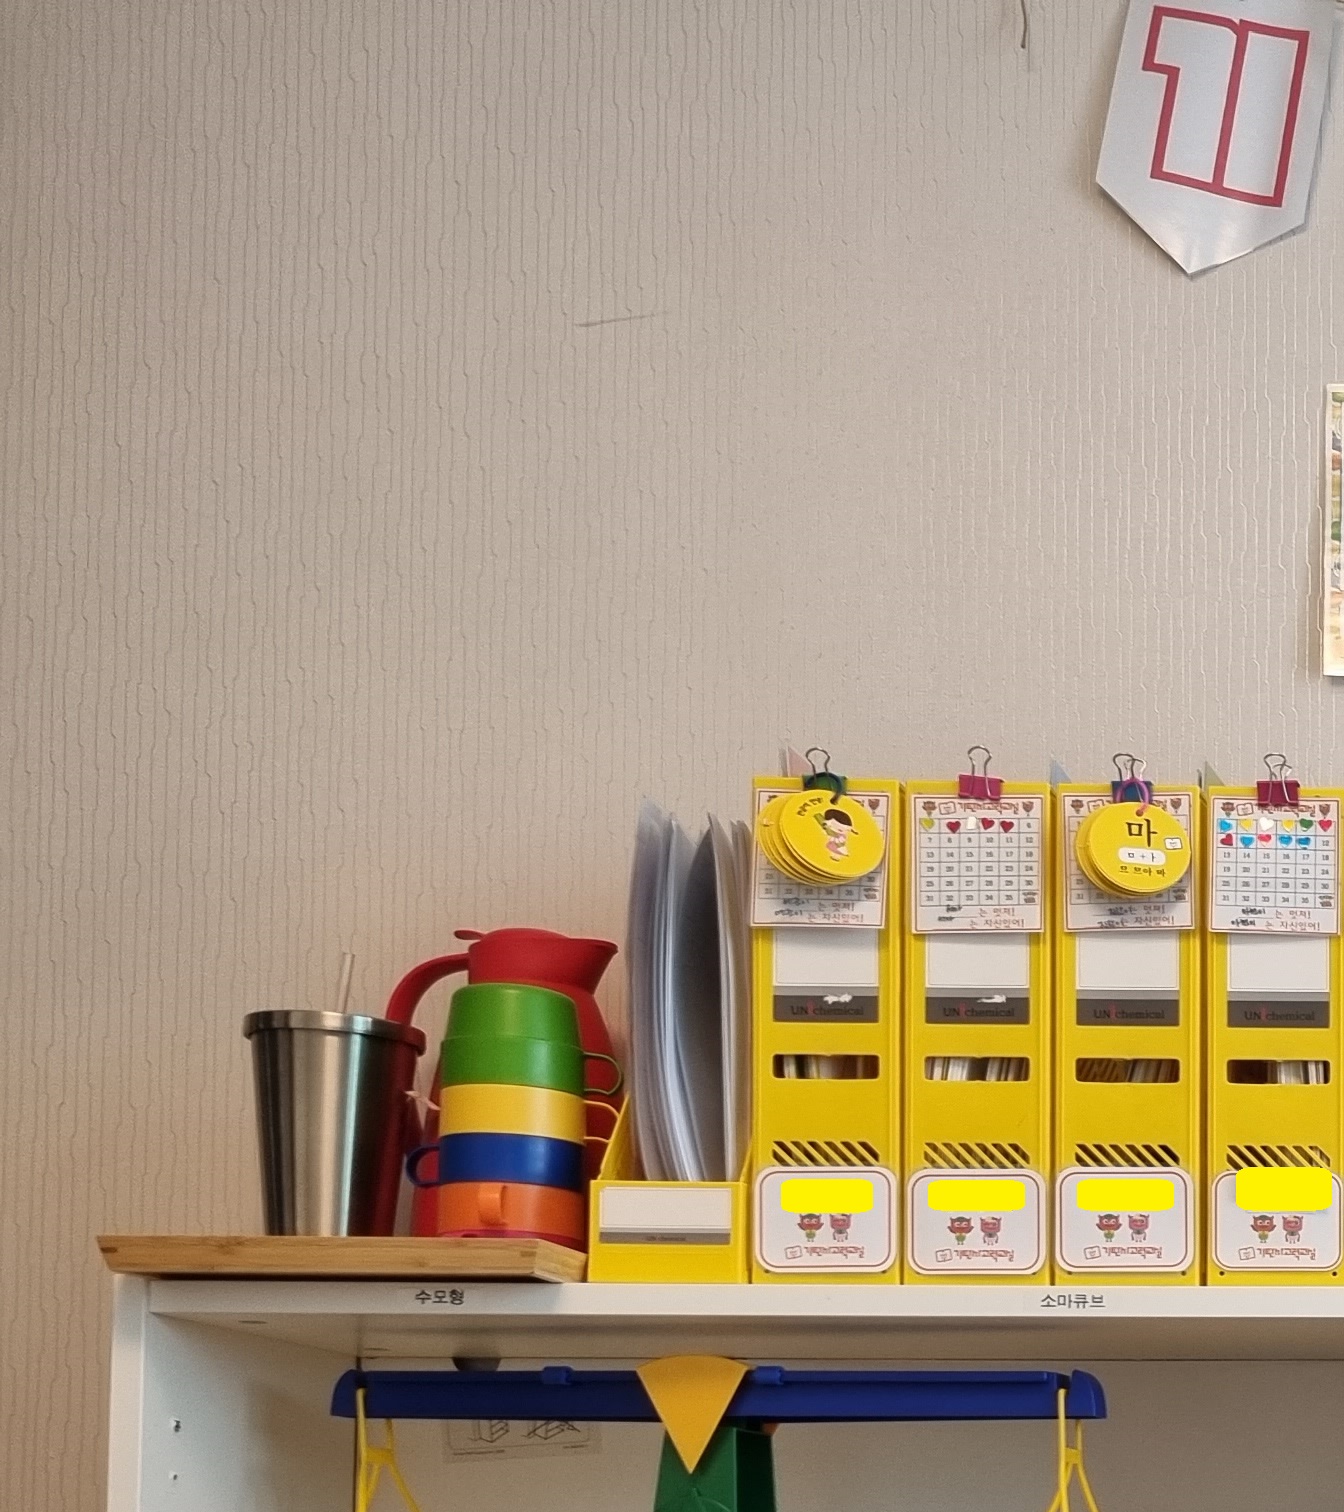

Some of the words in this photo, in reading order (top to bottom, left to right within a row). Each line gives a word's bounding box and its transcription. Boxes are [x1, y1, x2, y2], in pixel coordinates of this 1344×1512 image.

[1126, 818, 1158, 848] 마
[415, 1288, 465, 1306] 수모형
[1040, 1293, 1106, 1310] 소마큐브
